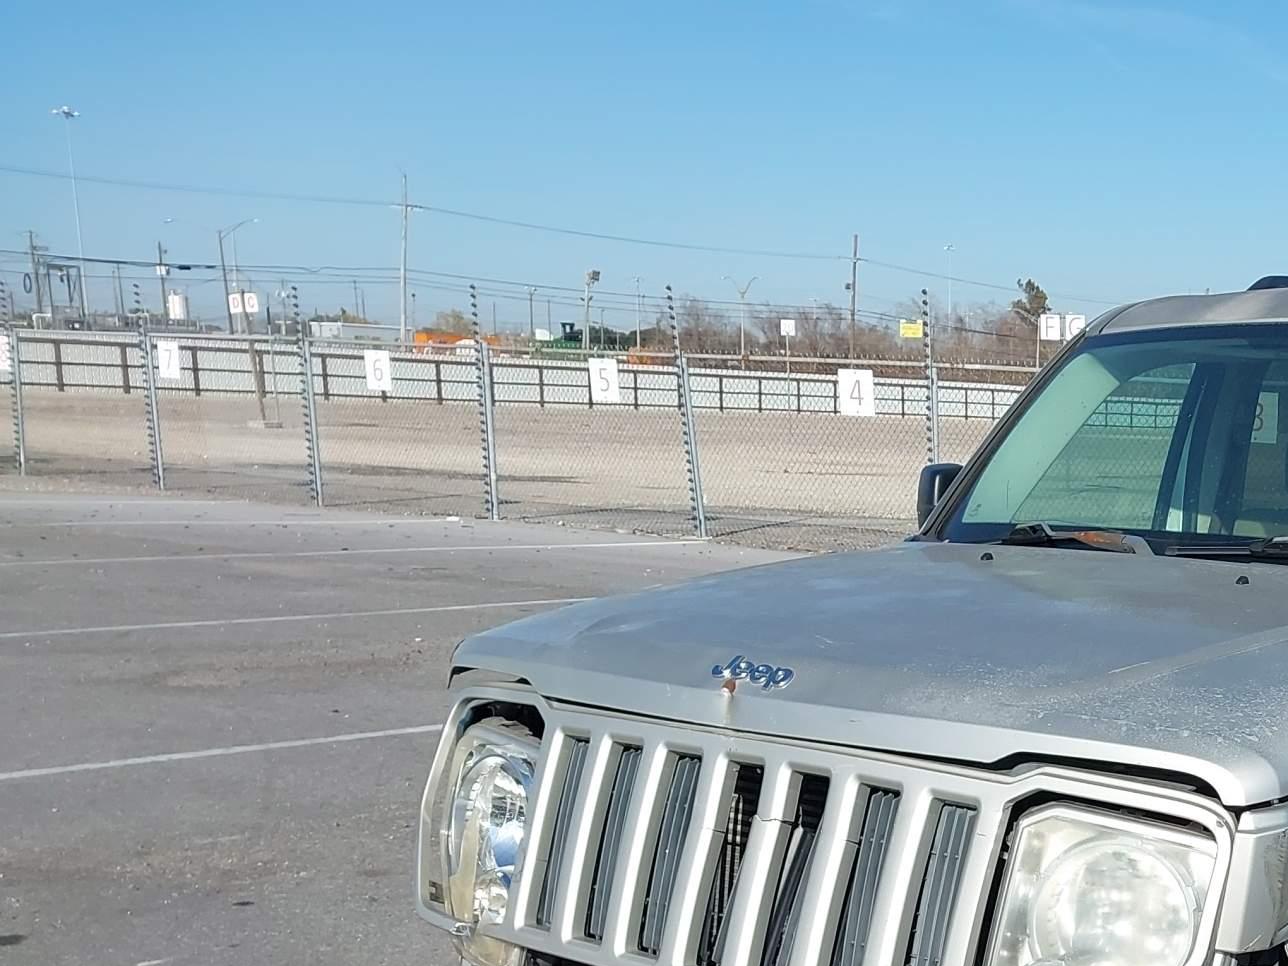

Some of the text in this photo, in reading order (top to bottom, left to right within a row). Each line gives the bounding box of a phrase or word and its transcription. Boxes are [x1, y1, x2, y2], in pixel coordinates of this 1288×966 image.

[1045, 316, 1056, 338] F
[163, 349, 172, 370] 7
[373, 358, 383, 381] 6
[599, 367, 610, 392] 5
[850, 380, 864, 406] 4
[711, 655, 795, 691] Jeep
